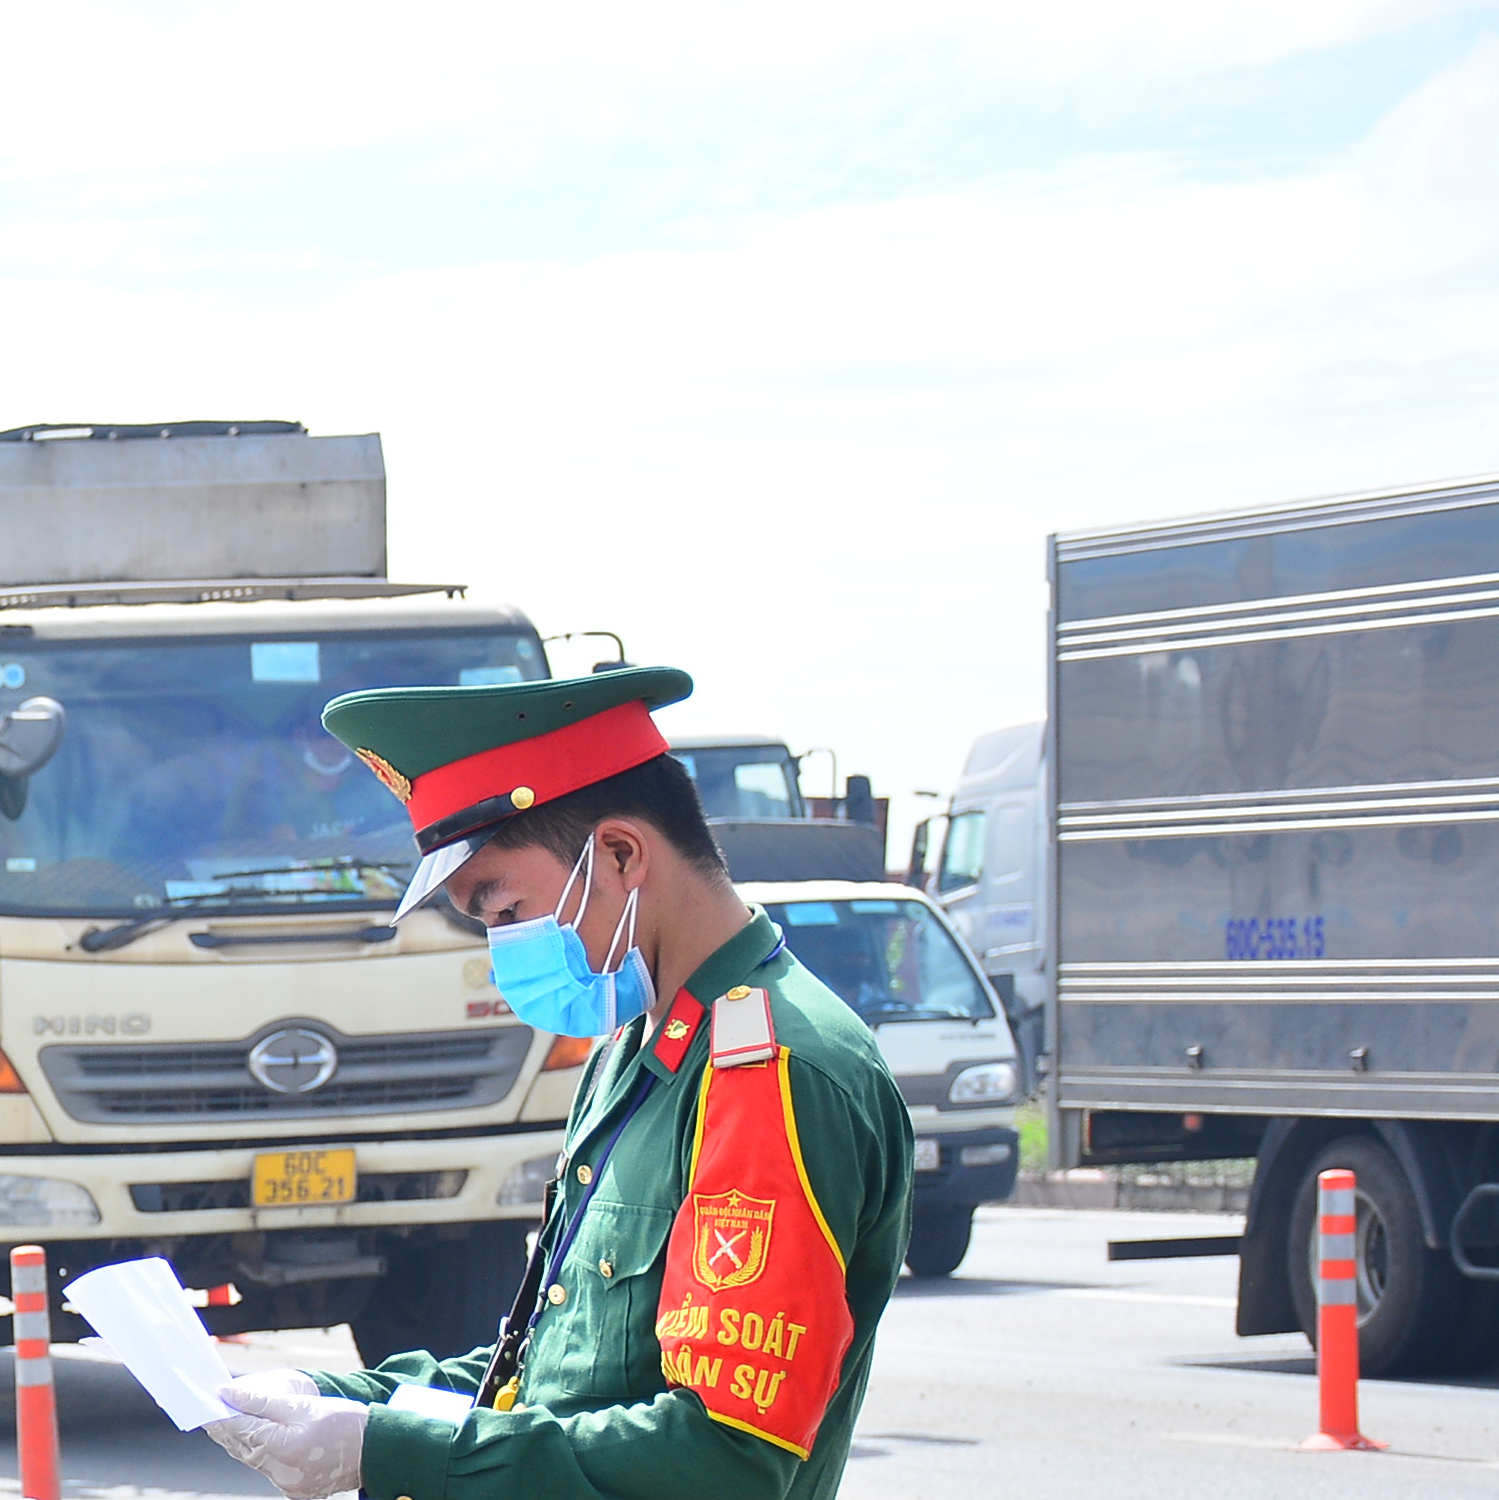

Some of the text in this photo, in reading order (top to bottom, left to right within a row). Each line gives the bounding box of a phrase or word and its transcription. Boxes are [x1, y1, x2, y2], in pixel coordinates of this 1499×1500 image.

[33, 1013, 152, 1036] HINO
[284, 1151, 326, 1175] 60C
[716, 1308, 807, 1361] SOÁT
[730, 1364, 786, 1415] SỰ
